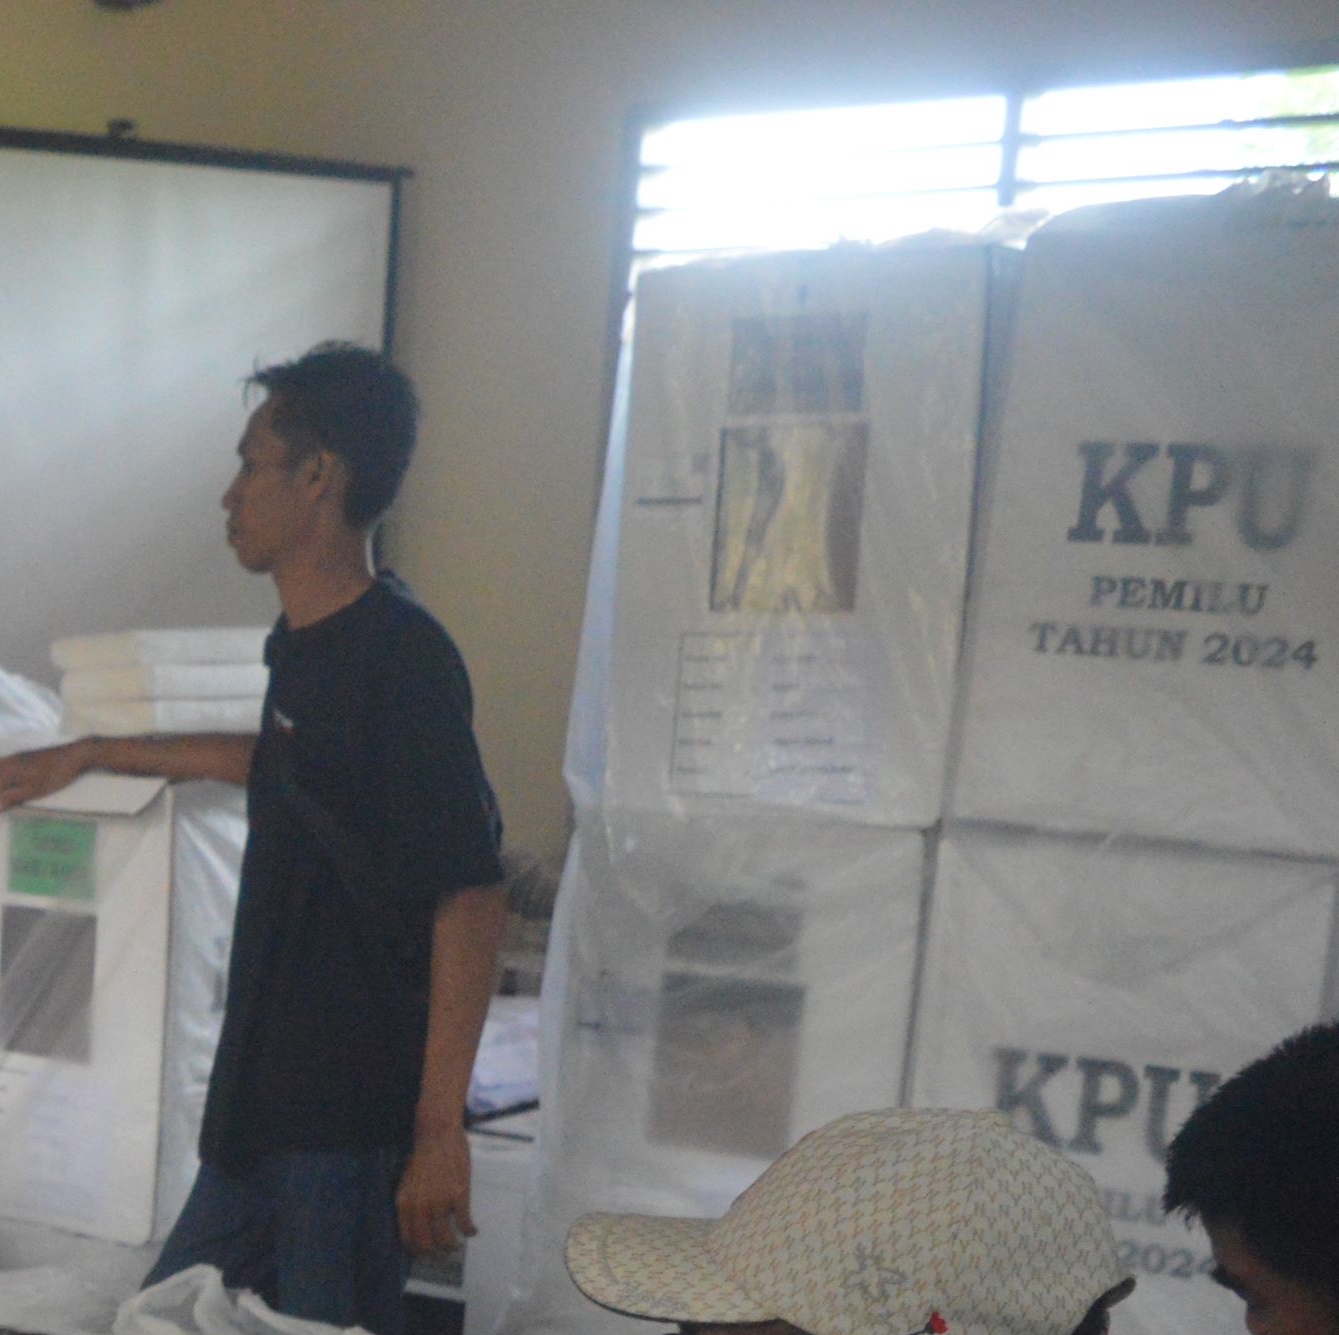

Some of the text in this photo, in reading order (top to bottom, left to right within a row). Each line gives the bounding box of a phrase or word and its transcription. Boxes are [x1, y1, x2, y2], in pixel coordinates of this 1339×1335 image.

[1067, 441, 1322, 552] KPU
[1089, 575, 1269, 616] PEMILU
[1029, 620, 1318, 670] TAHUN 2024
[995, 1048, 1222, 1161] KPU
